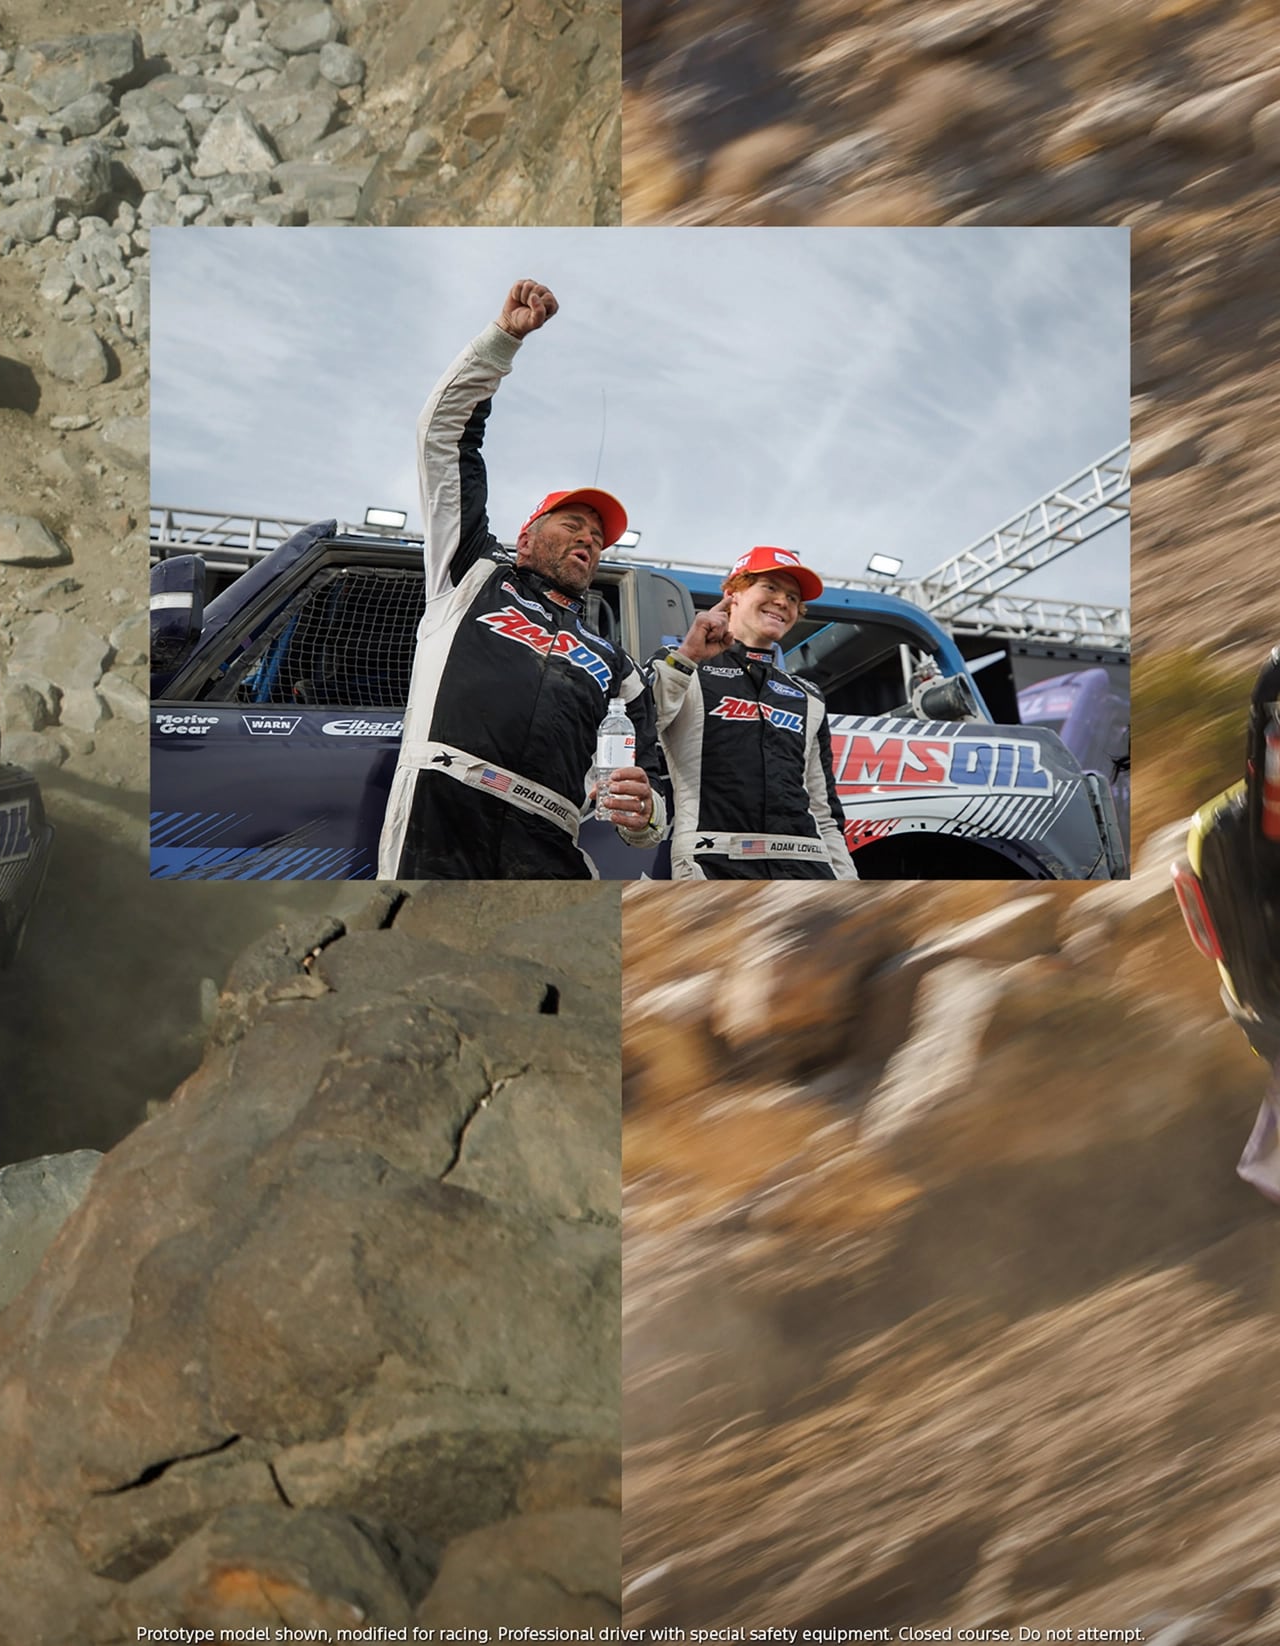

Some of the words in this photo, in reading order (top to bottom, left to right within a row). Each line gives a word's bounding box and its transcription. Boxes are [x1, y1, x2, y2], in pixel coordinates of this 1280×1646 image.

[480, 607, 612, 691] AMSOIL
[155, 714, 220, 725] Motive
[711, 697, 803, 732] AMSOIL
[160, 723, 210, 735] Gear
[252, 720, 291, 729] WARN
[322, 719, 404, 735] Eibach
[513, 784, 544, 804] BRAD
[544, 799, 569, 820] LOVELL
[770, 842, 795, 851] ADAM
[797, 844, 822, 854] LOVELL
